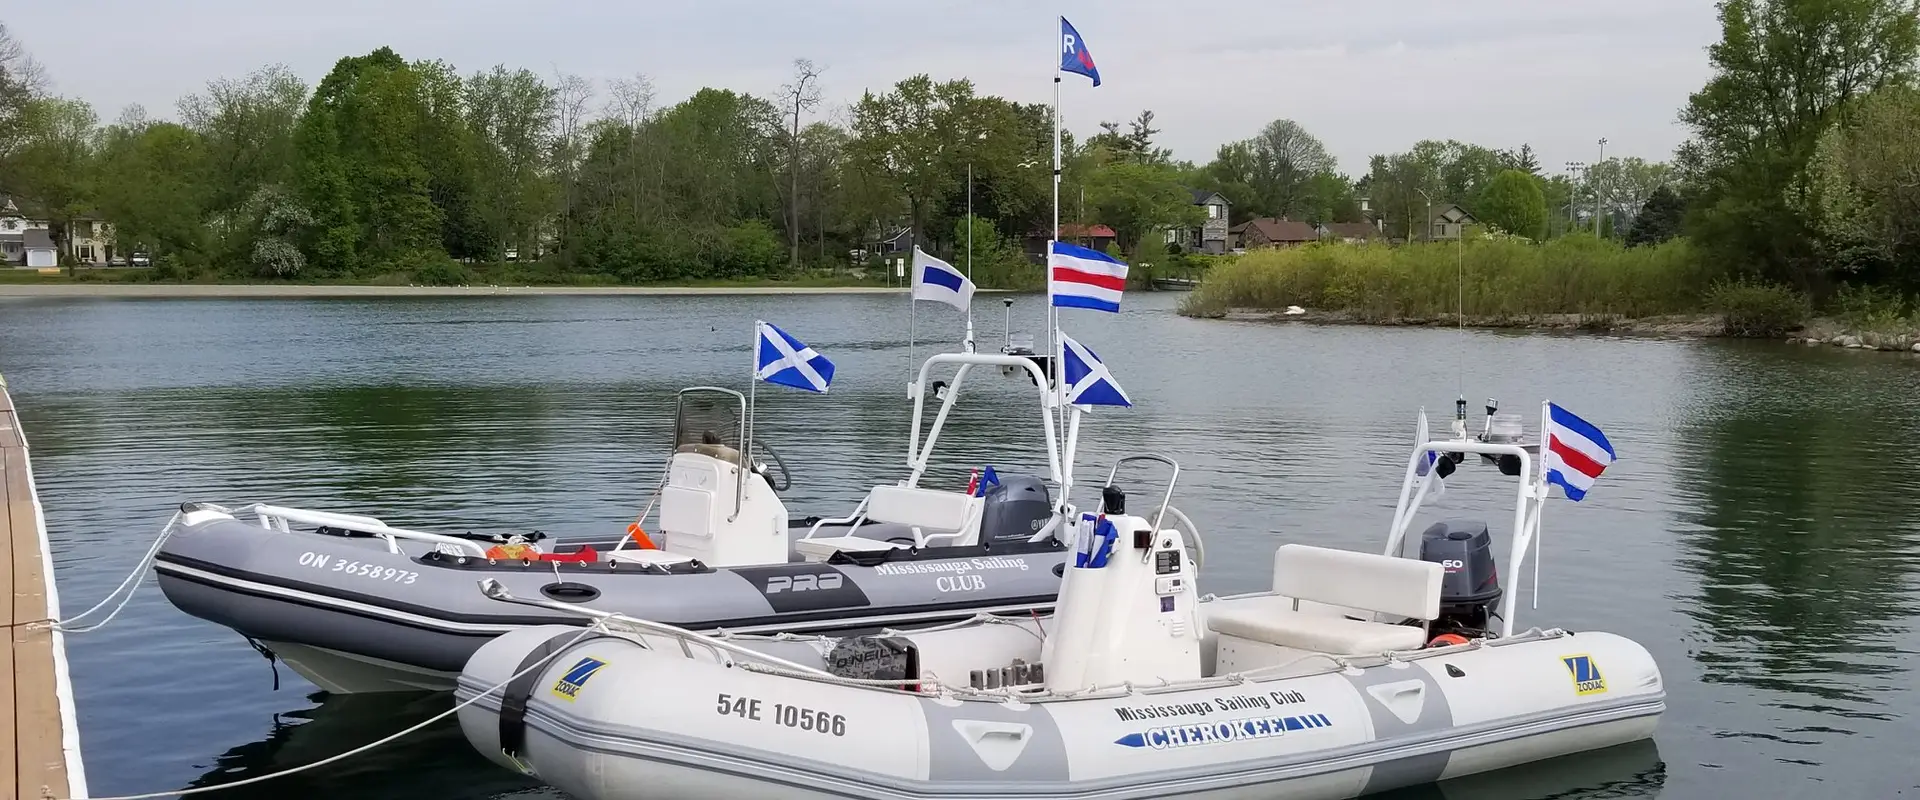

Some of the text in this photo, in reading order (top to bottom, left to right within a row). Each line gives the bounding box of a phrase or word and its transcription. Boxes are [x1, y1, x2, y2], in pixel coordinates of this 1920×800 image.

[1063, 33, 1075, 54] R
[299, 552, 419, 585] ON 3658973
[874, 557, 1029, 576] Mississauga Sailing
[766, 573, 843, 594] PRO
[936, 574, 986, 593] CLUB
[1576, 680, 1604, 692] ZODIAC
[717, 693, 846, 737] 54E 10566
[1114, 690, 1306, 722] Mississauga Sailing Club
[1147, 715, 1285, 750] CHEROKEE
